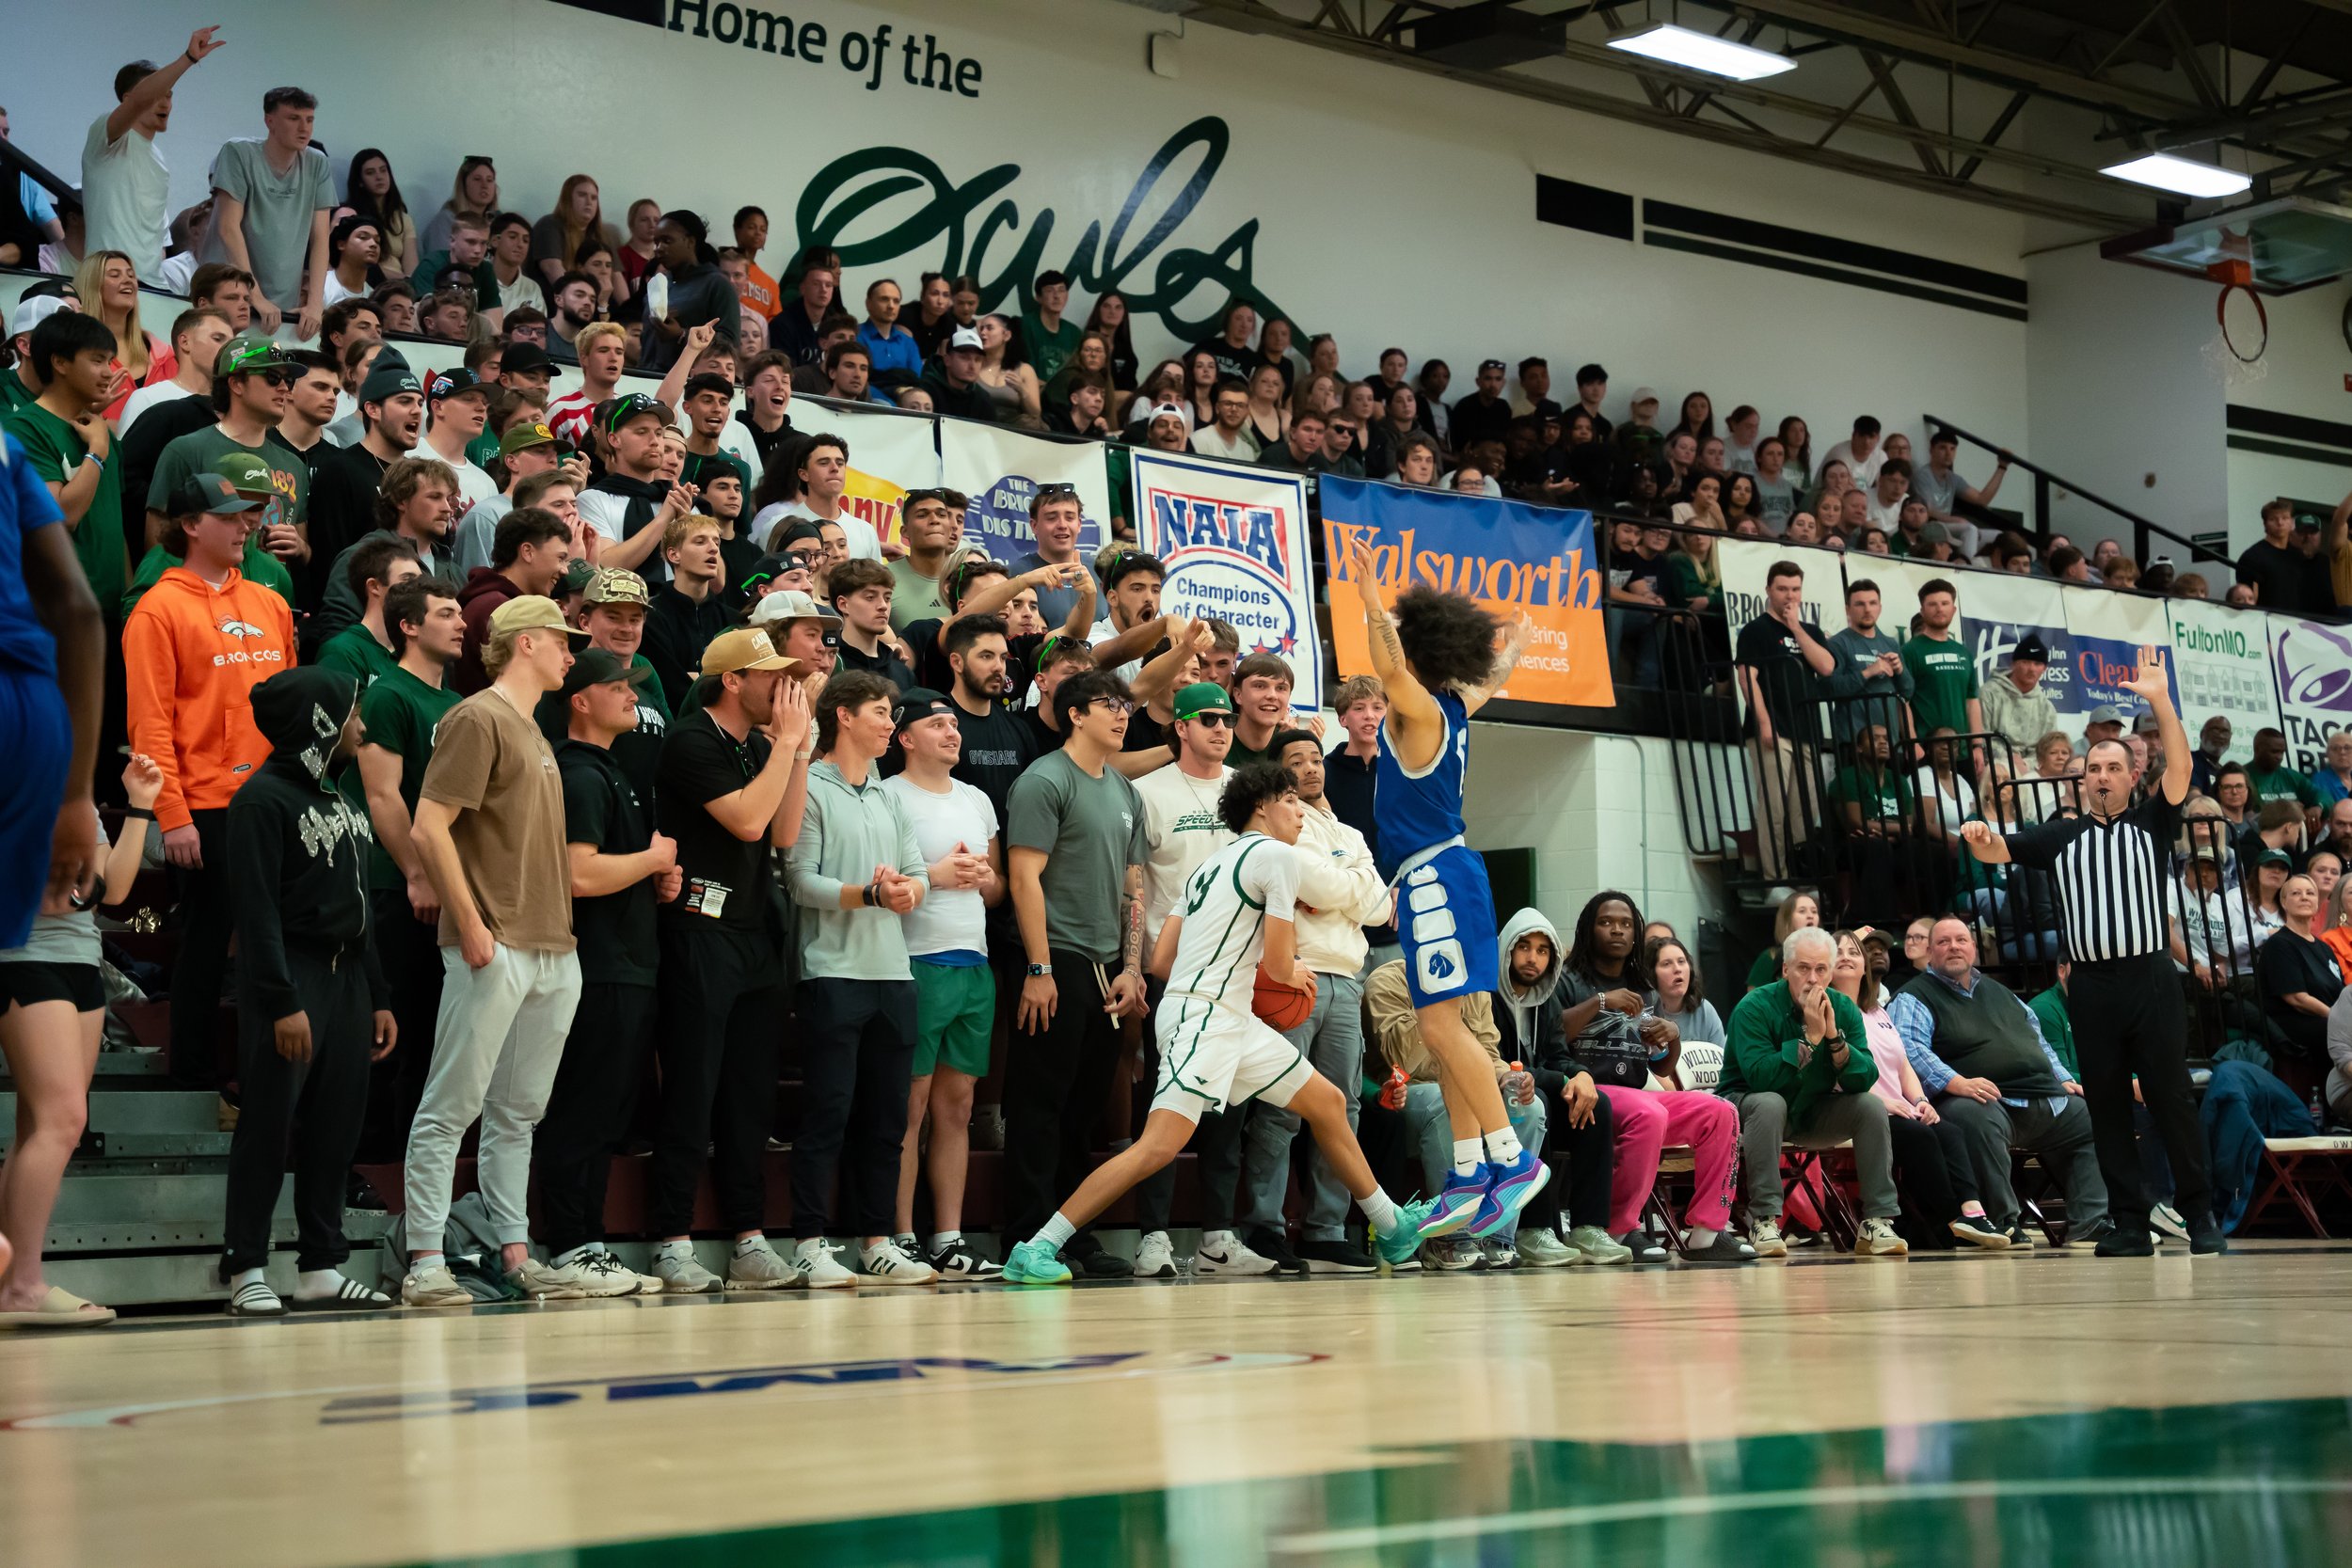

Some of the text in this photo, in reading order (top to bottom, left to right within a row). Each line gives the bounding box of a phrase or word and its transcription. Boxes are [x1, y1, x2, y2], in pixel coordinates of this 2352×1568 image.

[667, 0, 982, 98] Home of the
[1008, 478, 1029, 493] THE
[1154, 495, 1286, 578] NAIA
[1323, 518, 1600, 610] Walsworth
[1177, 578, 1271, 606] Champions
[1173, 601, 1280, 630] of Character
[2051, 645, 2066, 660] Inn
[2086, 688, 2113, 703] Today's
[2115, 691, 2132, 704] Best
[2284, 715, 2352, 751] TAC
